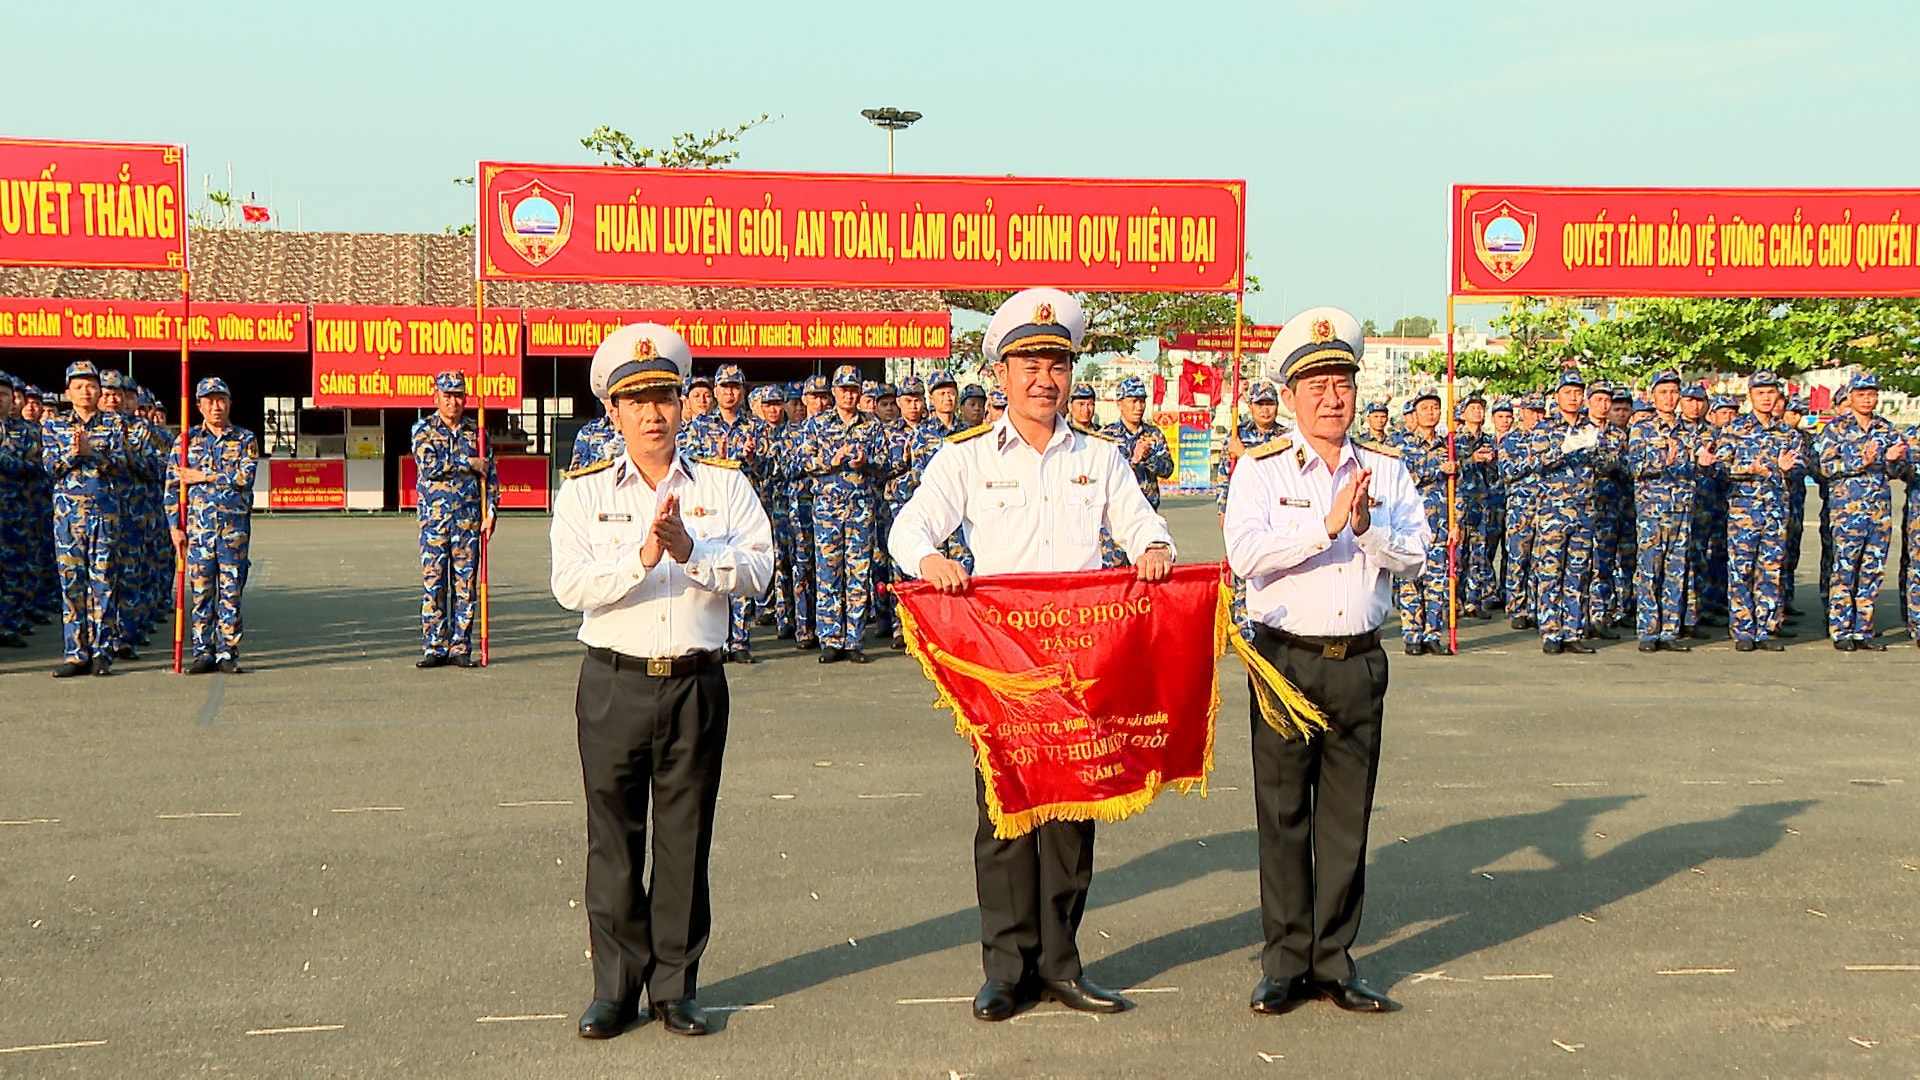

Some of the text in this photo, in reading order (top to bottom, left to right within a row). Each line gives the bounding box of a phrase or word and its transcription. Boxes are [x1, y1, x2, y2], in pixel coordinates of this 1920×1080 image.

[0, 163, 175, 238] UYẾT THẮNG
[596, 187, 1216, 273] HUẤN LUYỆN GIỎI, AN TOÀN, LÀM CHỦ, CHÍNH QUY, HIỆN ĐẠI
[1563, 209, 1614, 271] QUYẾT
[1618, 214, 1653, 266] TÂM
[1658, 209, 1691, 267] BẢO
[1696, 214, 1716, 276] VỆ
[1720, 214, 1765, 267] VỮNG
[1769, 207, 1814, 267] CHẮC
[1818, 209, 1852, 267] CHỦ
[18, 308, 61, 336] CHÂM
[96, 307, 131, 342] BẢN,
[134, 309, 171, 339] THIẾT
[217, 313, 254, 340] VỮNG
[316, 316, 518, 360] KHU VỰC TRƯNG BÀY
[531, 316, 562, 346] HUẤN
[566, 319, 601, 350] LUYỆN
[689, 318, 710, 348] TỐT,
[713, 317, 727, 346] KỶ
[730, 320, 756, 352] LUẬT
[759, 321, 804, 349] NGHIÊM,
[833, 322, 863, 347] SÀNG
[865, 319, 897, 347] CHIẾN
[900, 319, 921, 347] ĐẤU
[924, 326, 945, 348] CAO
[320, 370, 356, 395] SÁNG
[360, 368, 394, 397] KIẾN,
[476, 372, 516, 401] UYỆN
[1007, 603, 1071, 631] QUỐC
